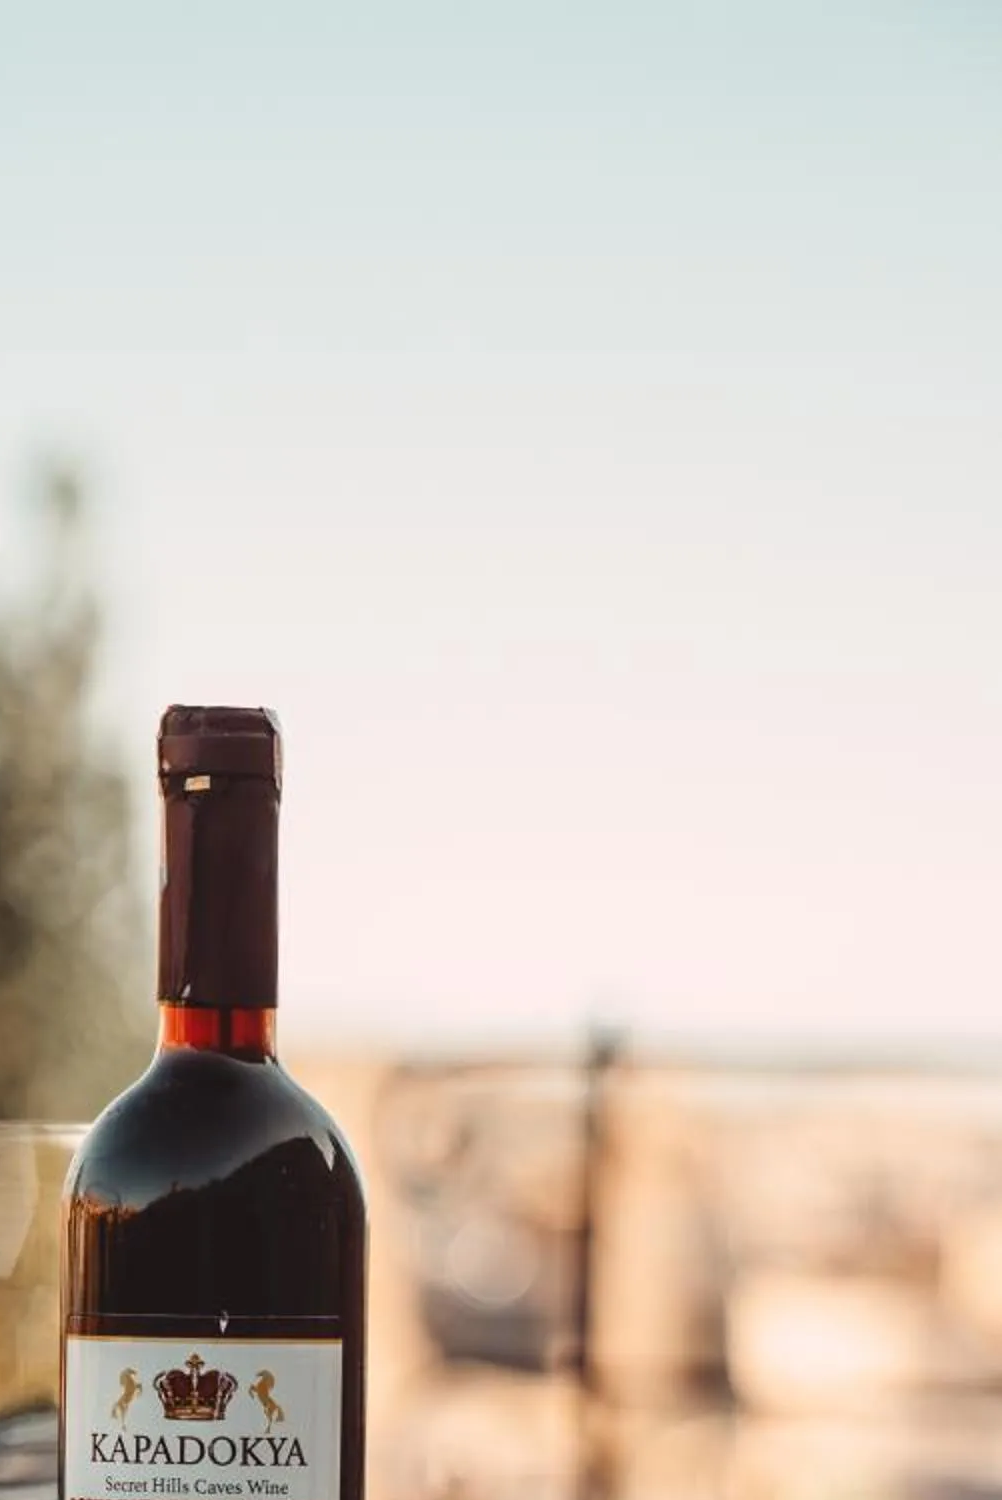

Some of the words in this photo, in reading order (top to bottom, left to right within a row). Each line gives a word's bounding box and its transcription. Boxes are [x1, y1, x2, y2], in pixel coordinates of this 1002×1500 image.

[90, 1432, 308, 1466] KAPADOKYA
[105, 1476, 147, 1493] Secret
[152, 1477, 189, 1494] Hills
[194, 1478, 243, 1495] Caves
[247, 1479, 289, 1496] Wine
